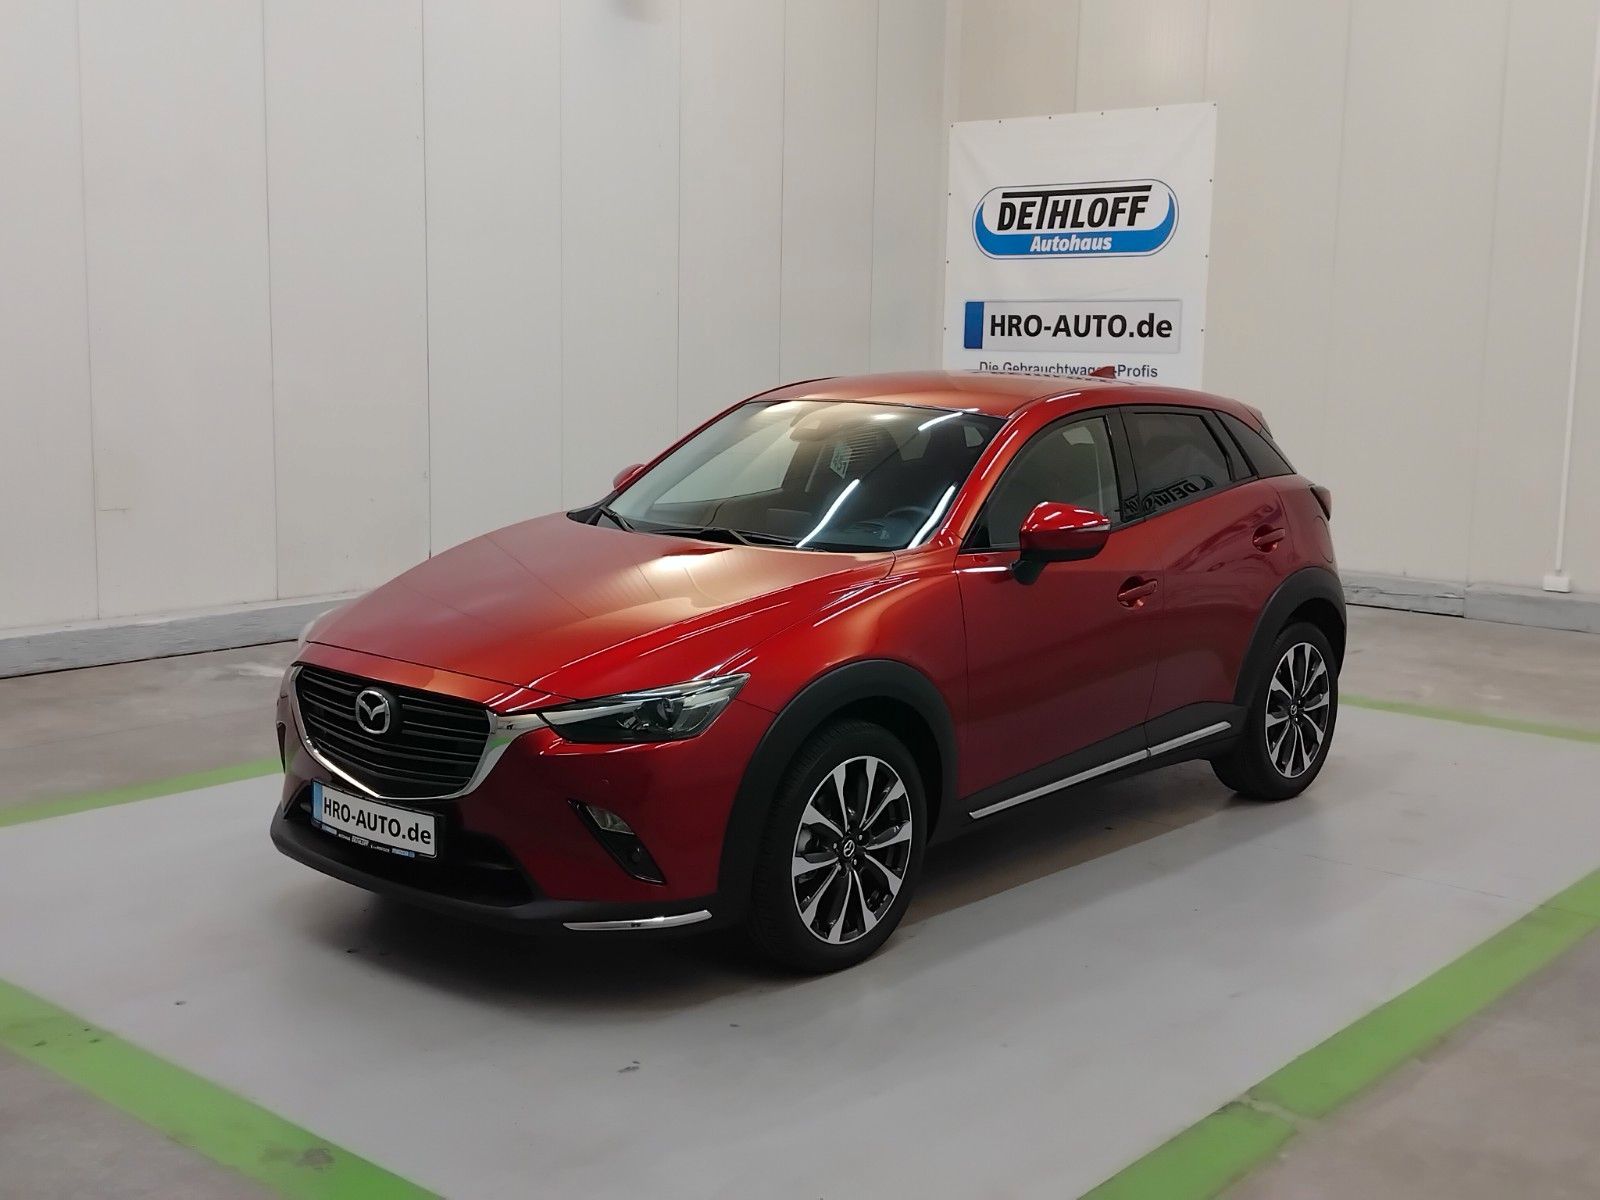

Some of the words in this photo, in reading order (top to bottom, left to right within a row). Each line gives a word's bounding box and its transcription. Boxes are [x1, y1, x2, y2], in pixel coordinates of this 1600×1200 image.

[997, 185, 1152, 230] DETHLOFF
[1030, 235, 1112, 252] Autohaus
[990, 312, 1173, 338] HRO-AUTO.de
[979, 361, 998, 371] Die
[324, 797, 431, 844] HRO-AUTO.de
